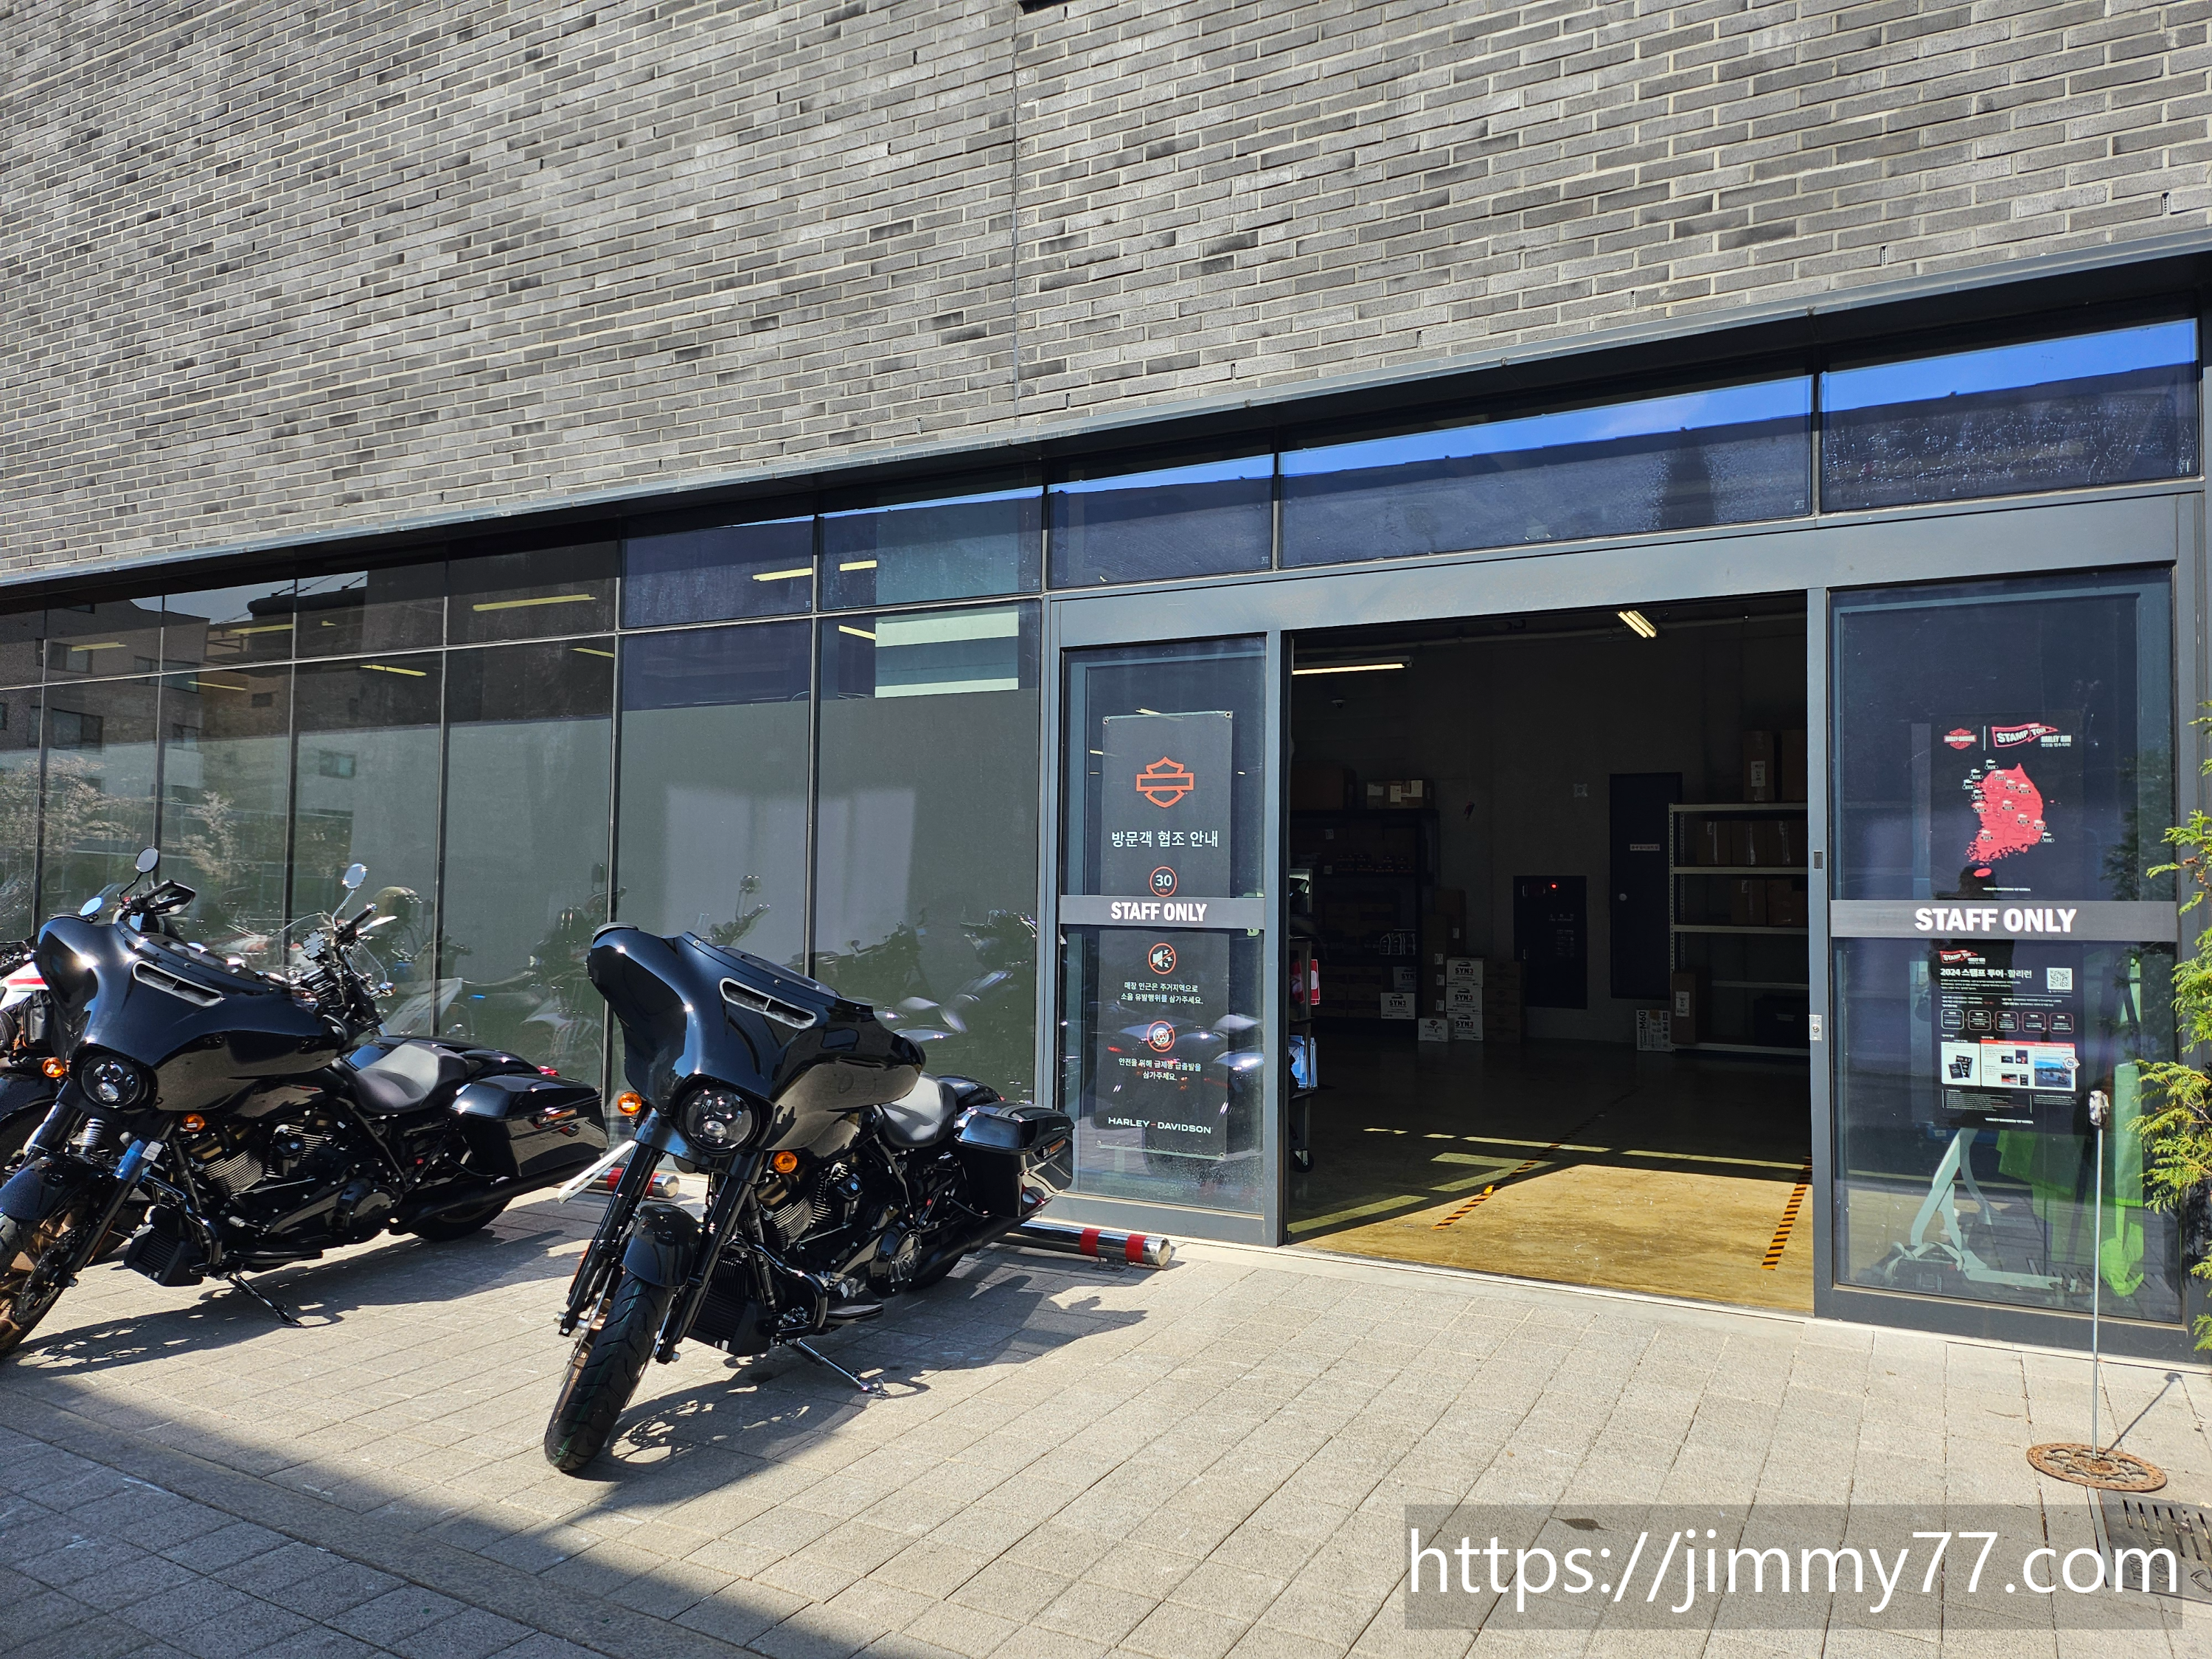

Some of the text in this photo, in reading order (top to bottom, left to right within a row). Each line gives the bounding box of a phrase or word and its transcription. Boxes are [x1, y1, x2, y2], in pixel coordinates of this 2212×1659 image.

[1997, 730, 2028, 743] STAMP
[1111, 830, 1218, 847] 방문객 협조 안내
[1155, 874, 1172, 887] 30
[1111, 902, 1208, 922] STAFF ONLY
[1914, 908, 2077, 933] STAFF ONLY
[1940, 968, 1961, 976] 2024
[1986, 969, 2004, 978] 투어
[1124, 981, 1198, 992] 매장 인근은 주거지역으로
[1135, 993, 1168, 1003] 유발행위를
[1638, 1011, 1646, 1029] M60
[1119, 1057, 1137, 1068] 안전을
[1138, 1059, 1152, 1068] 위해
